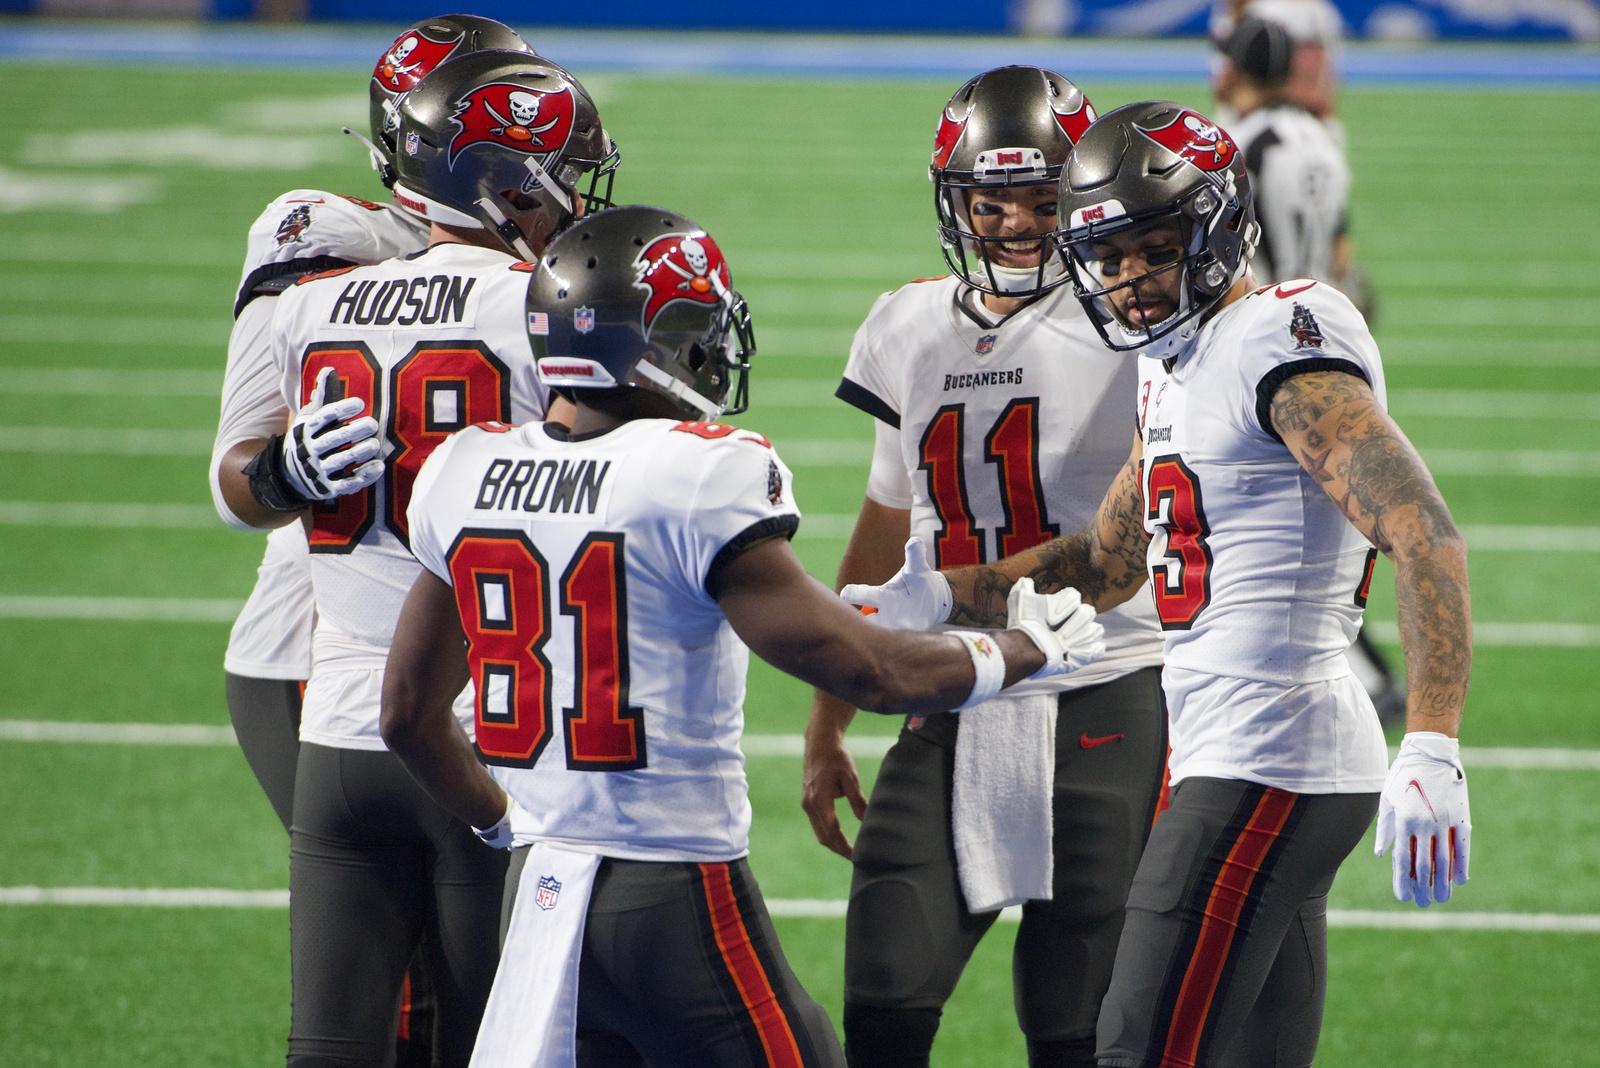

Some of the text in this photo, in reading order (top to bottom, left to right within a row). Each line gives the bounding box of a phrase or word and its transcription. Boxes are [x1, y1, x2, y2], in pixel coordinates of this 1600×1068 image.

[329, 274, 477, 326] HUDSON
[943, 368, 1023, 391] BUCCANEERS
[474, 458, 611, 514] BROWN
[917, 396, 1061, 570] 11
[1137, 453, 1214, 631] 3
[444, 527, 648, 771] 81
